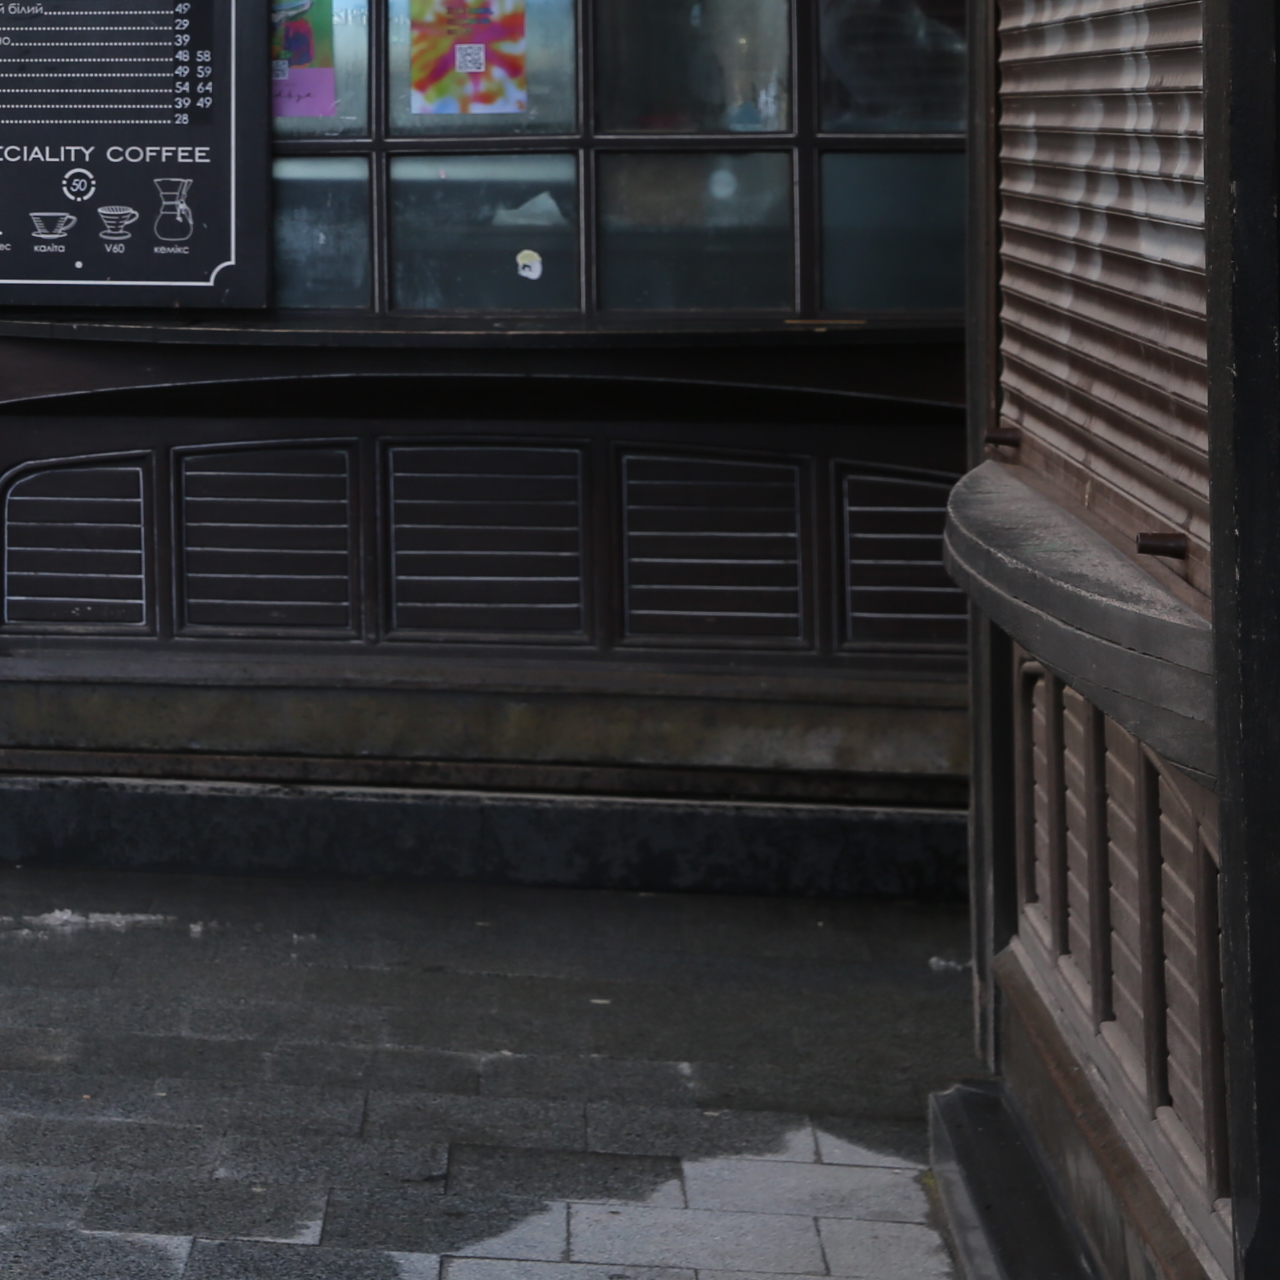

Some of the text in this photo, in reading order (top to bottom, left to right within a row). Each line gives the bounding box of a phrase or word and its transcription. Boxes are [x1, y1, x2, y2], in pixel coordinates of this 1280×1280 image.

[8, 3, 43, 15] білий
[174, 3, 191, 14] 49
[174, 19, 190, 30] 29
[174, 34, 190, 46] 39
[174, 50, 190, 62] 48
[196, 50, 211, 62] 58
[174, 65, 190, 77] 49
[196, 65, 212, 77] 59
[174, 81, 190, 93] 54
[196, 81, 213, 93] 64
[174, 97, 191, 109] 39
[196, 97, 213, 108] 49
[174, 113, 189, 125] 28
[106, 146, 211, 162] COFFEE
[70, 179, 88, 192] 50
[33, 243, 65, 253] каліта
[104, 243, 126, 254] V60
[153, 243, 189, 254] кемікс
